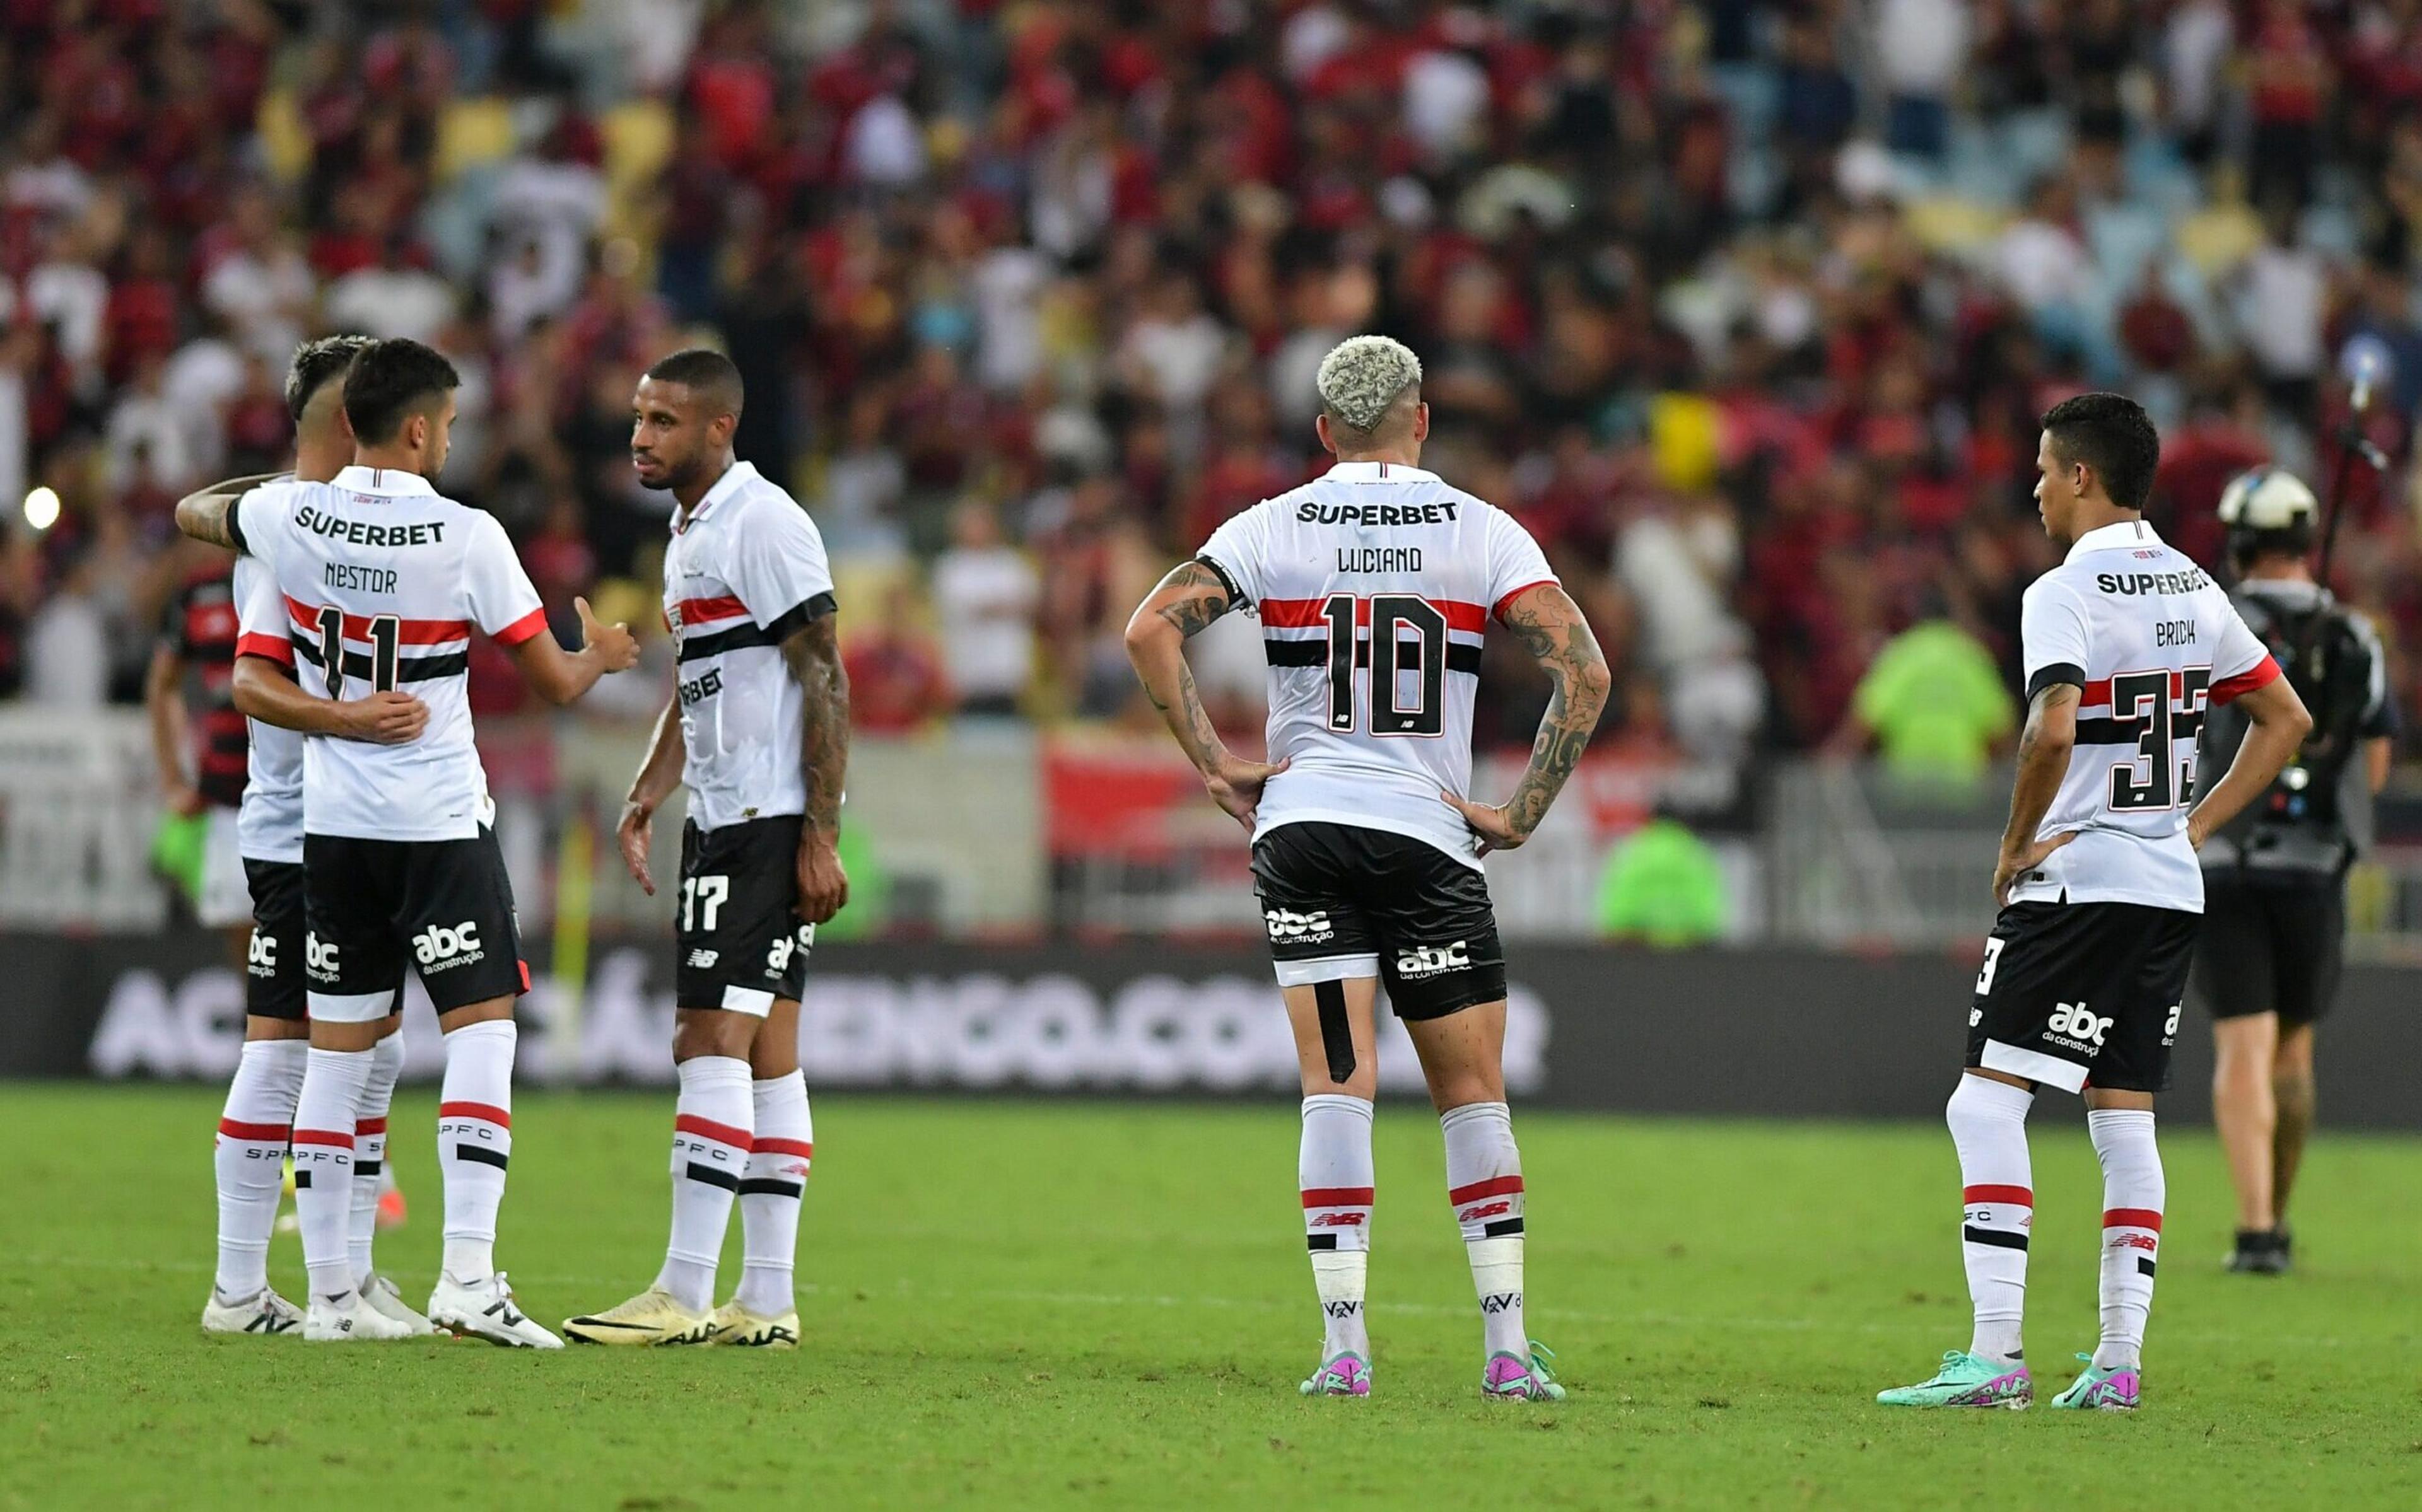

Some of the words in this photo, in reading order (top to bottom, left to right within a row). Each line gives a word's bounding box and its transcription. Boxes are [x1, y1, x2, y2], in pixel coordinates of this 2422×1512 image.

[295, 506, 445, 547] SUPERBET
[1296, 502, 1458, 526] SUPERBET
[1338, 548, 1422, 573] LUCIANO
[316, 603, 401, 701] 11
[1321, 592, 1448, 737] 10
[683, 875, 729, 932] 17
[412, 921, 481, 964] abc
[433, 950, 484, 972] construção
[1397, 940, 1470, 973] abc
[2042, 1032, 2055, 1042] da
[2048, 1001, 2114, 1047] abc
[437, 1124, 493, 1140] PFC
